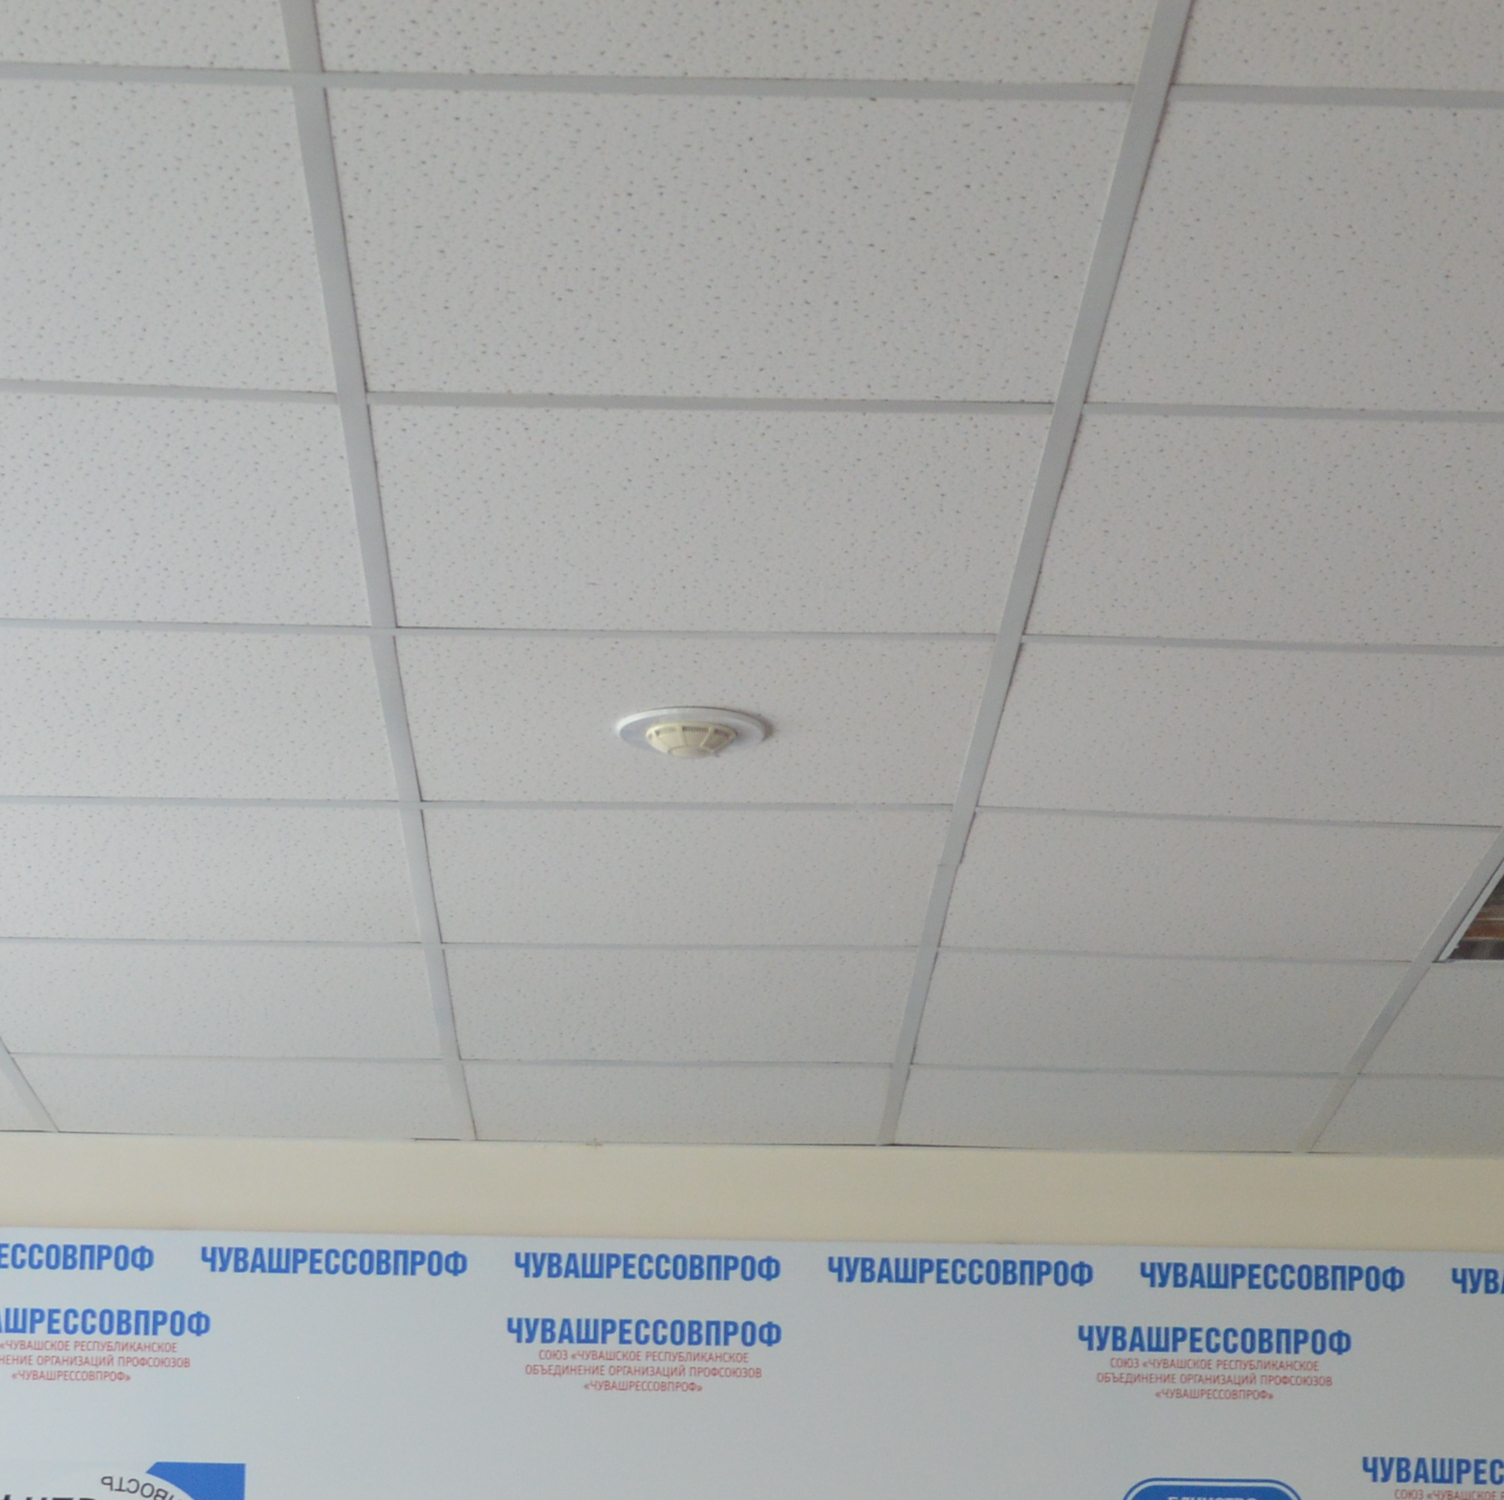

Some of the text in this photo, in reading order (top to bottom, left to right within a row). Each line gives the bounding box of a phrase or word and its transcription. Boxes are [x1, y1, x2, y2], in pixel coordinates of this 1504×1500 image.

[201, 1246, 468, 1276] ЧУВАШРЕССОВПРОФ
[515, 1252, 781, 1281] ЧУВАШРЕССОВПРОФ
[828, 1257, 1094, 1286] ЧУВАШРЕССОВПРОФ
[1140, 1262, 1405, 1292] ЧУВАШРЕССОВПРОФ
[507, 1318, 782, 1347] ЧУВАШРЕССОВПРОФ
[1078, 1325, 1352, 1355] ЧУВАШРЕССОВПРОФ
[0, 1339, 71, 1351] «ЧУВАШСКОЕ
[74, 1340, 178, 1353] РЕСПУБЛИКАНСКОЕ
[37, 1354, 115, 1368] ОРГАНИЗАЦИЙ
[118, 1355, 192, 1369] ПРОФСОЮЗОВ
[539, 1349, 750, 1364] СОЮЗ «ЧУВАШСКОЕ РЕСПУБЛИКАНСКОЕ
[525, 1363, 764, 1379] ОБЪЕДИНЕНИЕ ОРГАНИЗАЦИЙ ПРОФСОЮЗОВ
[1110, 1357, 1320, 1372] СОЮЗ «ЧУВАШСКОЕ РЕСПУБЛИКАНСКОЕ
[11, 1370, 133, 1382] «ЧУВАШРЕССОВПРОФ»
[1097, 1371, 1334, 1388] ОБЪЕДИНЕНИЕ ОРГАНИЗАЦИЙ ПРОФСОЮЗОВ
[584, 1380, 704, 1392] «ЧУВАШРЕССОВПРОФ»
[1155, 1388, 1275, 1400] «ЧУВАШРЕССОВПРОФ»
[1394, 1489, 1425, 1500] СОЮЗ
